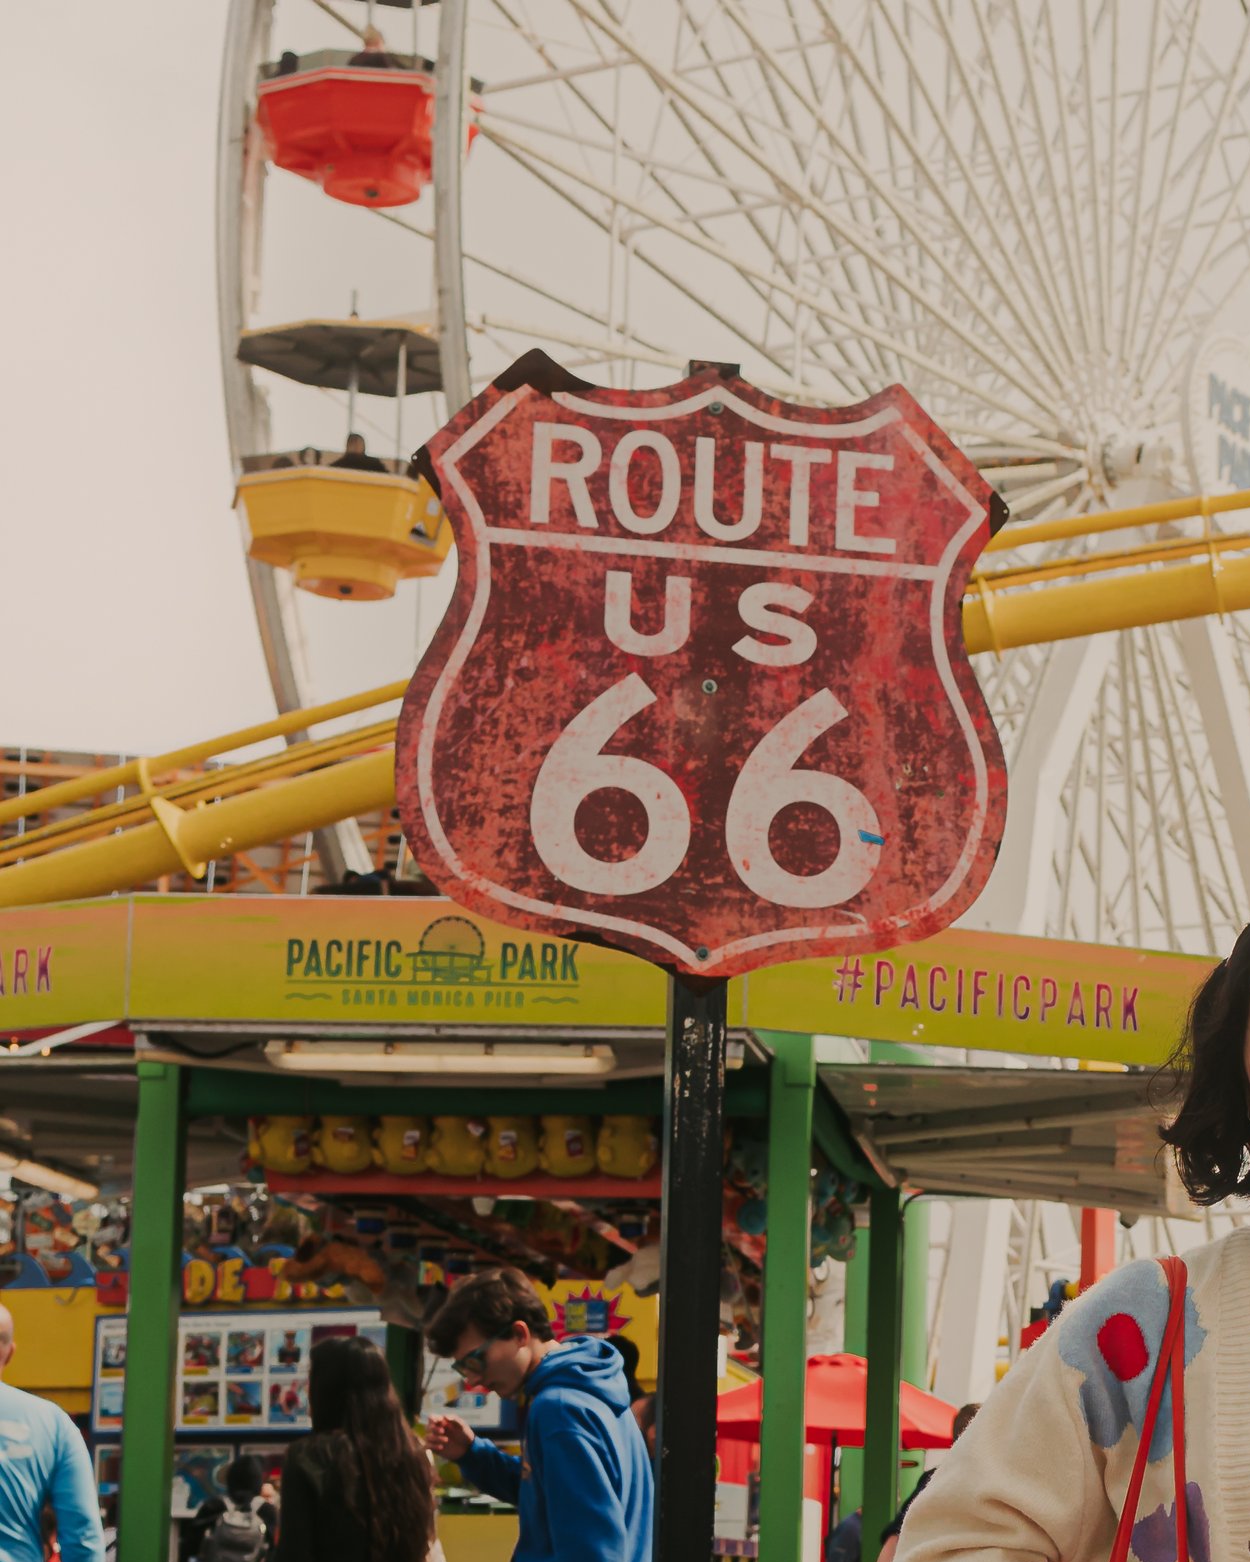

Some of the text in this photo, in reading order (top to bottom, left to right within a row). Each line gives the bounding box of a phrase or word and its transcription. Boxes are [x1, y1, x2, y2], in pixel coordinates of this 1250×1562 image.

[529, 420, 897, 555] ROUTE
[529, 671, 882, 909] 66
[286, 938, 580, 982] PACIFIC PARK
[341, 988, 526, 1009] SANTA MONICA PIER
[832, 955, 1140, 1033] #PACIFICPARK
